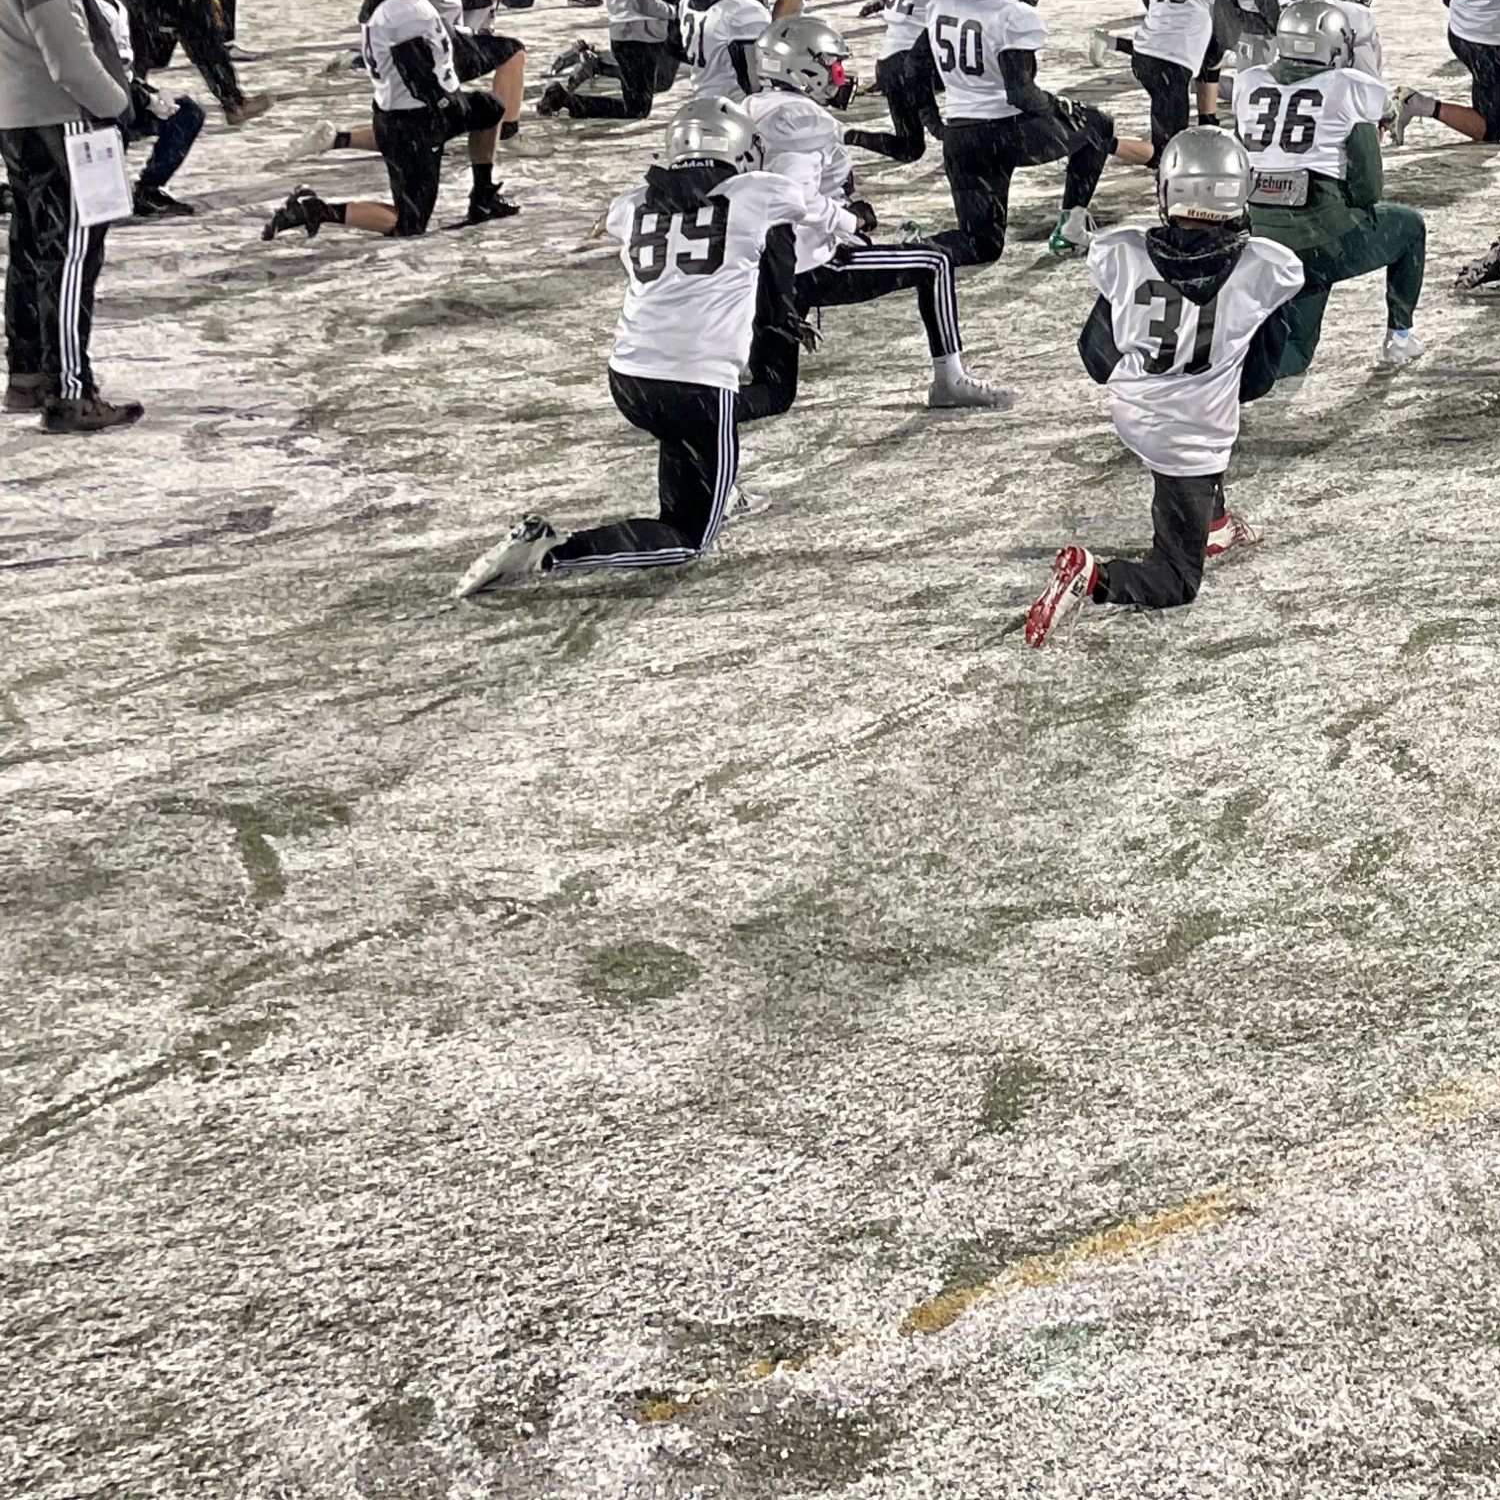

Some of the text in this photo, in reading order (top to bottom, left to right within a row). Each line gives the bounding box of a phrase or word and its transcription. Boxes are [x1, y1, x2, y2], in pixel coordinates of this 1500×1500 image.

[936, 15, 984, 76] 50
[1244, 87, 1323, 154] 36
[629, 194, 730, 284] 89
[1135, 280, 1218, 373] 31
